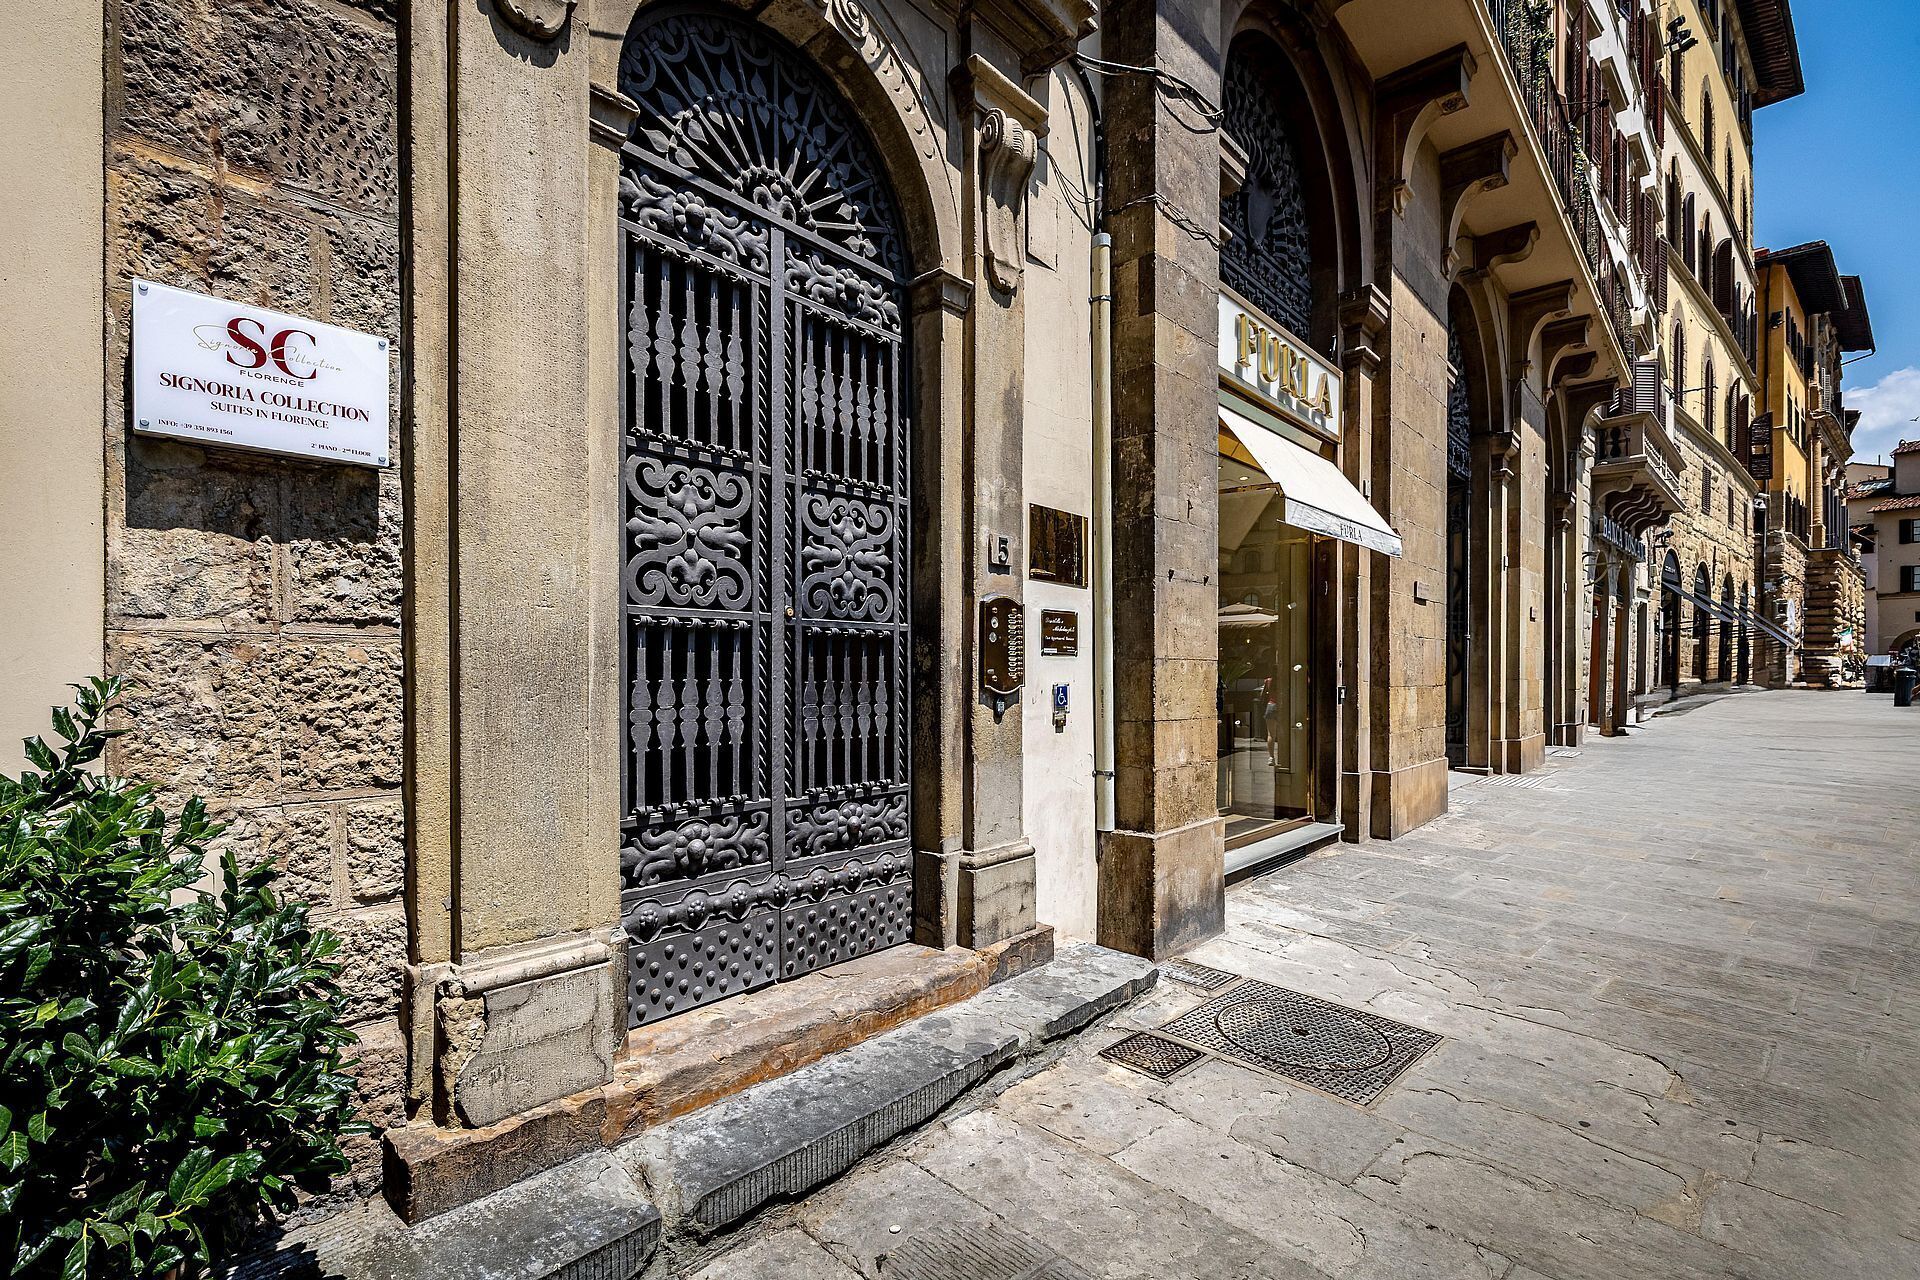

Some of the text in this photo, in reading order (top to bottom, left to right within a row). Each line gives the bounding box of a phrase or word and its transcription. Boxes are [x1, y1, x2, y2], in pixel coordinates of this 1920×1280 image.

[193, 324, 344, 371] Signoria Collection
[226, 317, 317, 380] SC
[239, 369, 304, 387] FLORENCE
[1235, 313, 1333, 419] FURLA
[159, 372, 370, 424] SIGNORIA COLLECTION
[158, 418, 179, 427] INFO:
[210, 400, 329, 430] SUITES IN FLORENCE
[318, 444, 338, 452] PIANO
[351, 449, 371, 457] FLOOR
[1340, 523, 1363, 542] FURLA
[998, 536, 1010, 565] 5
